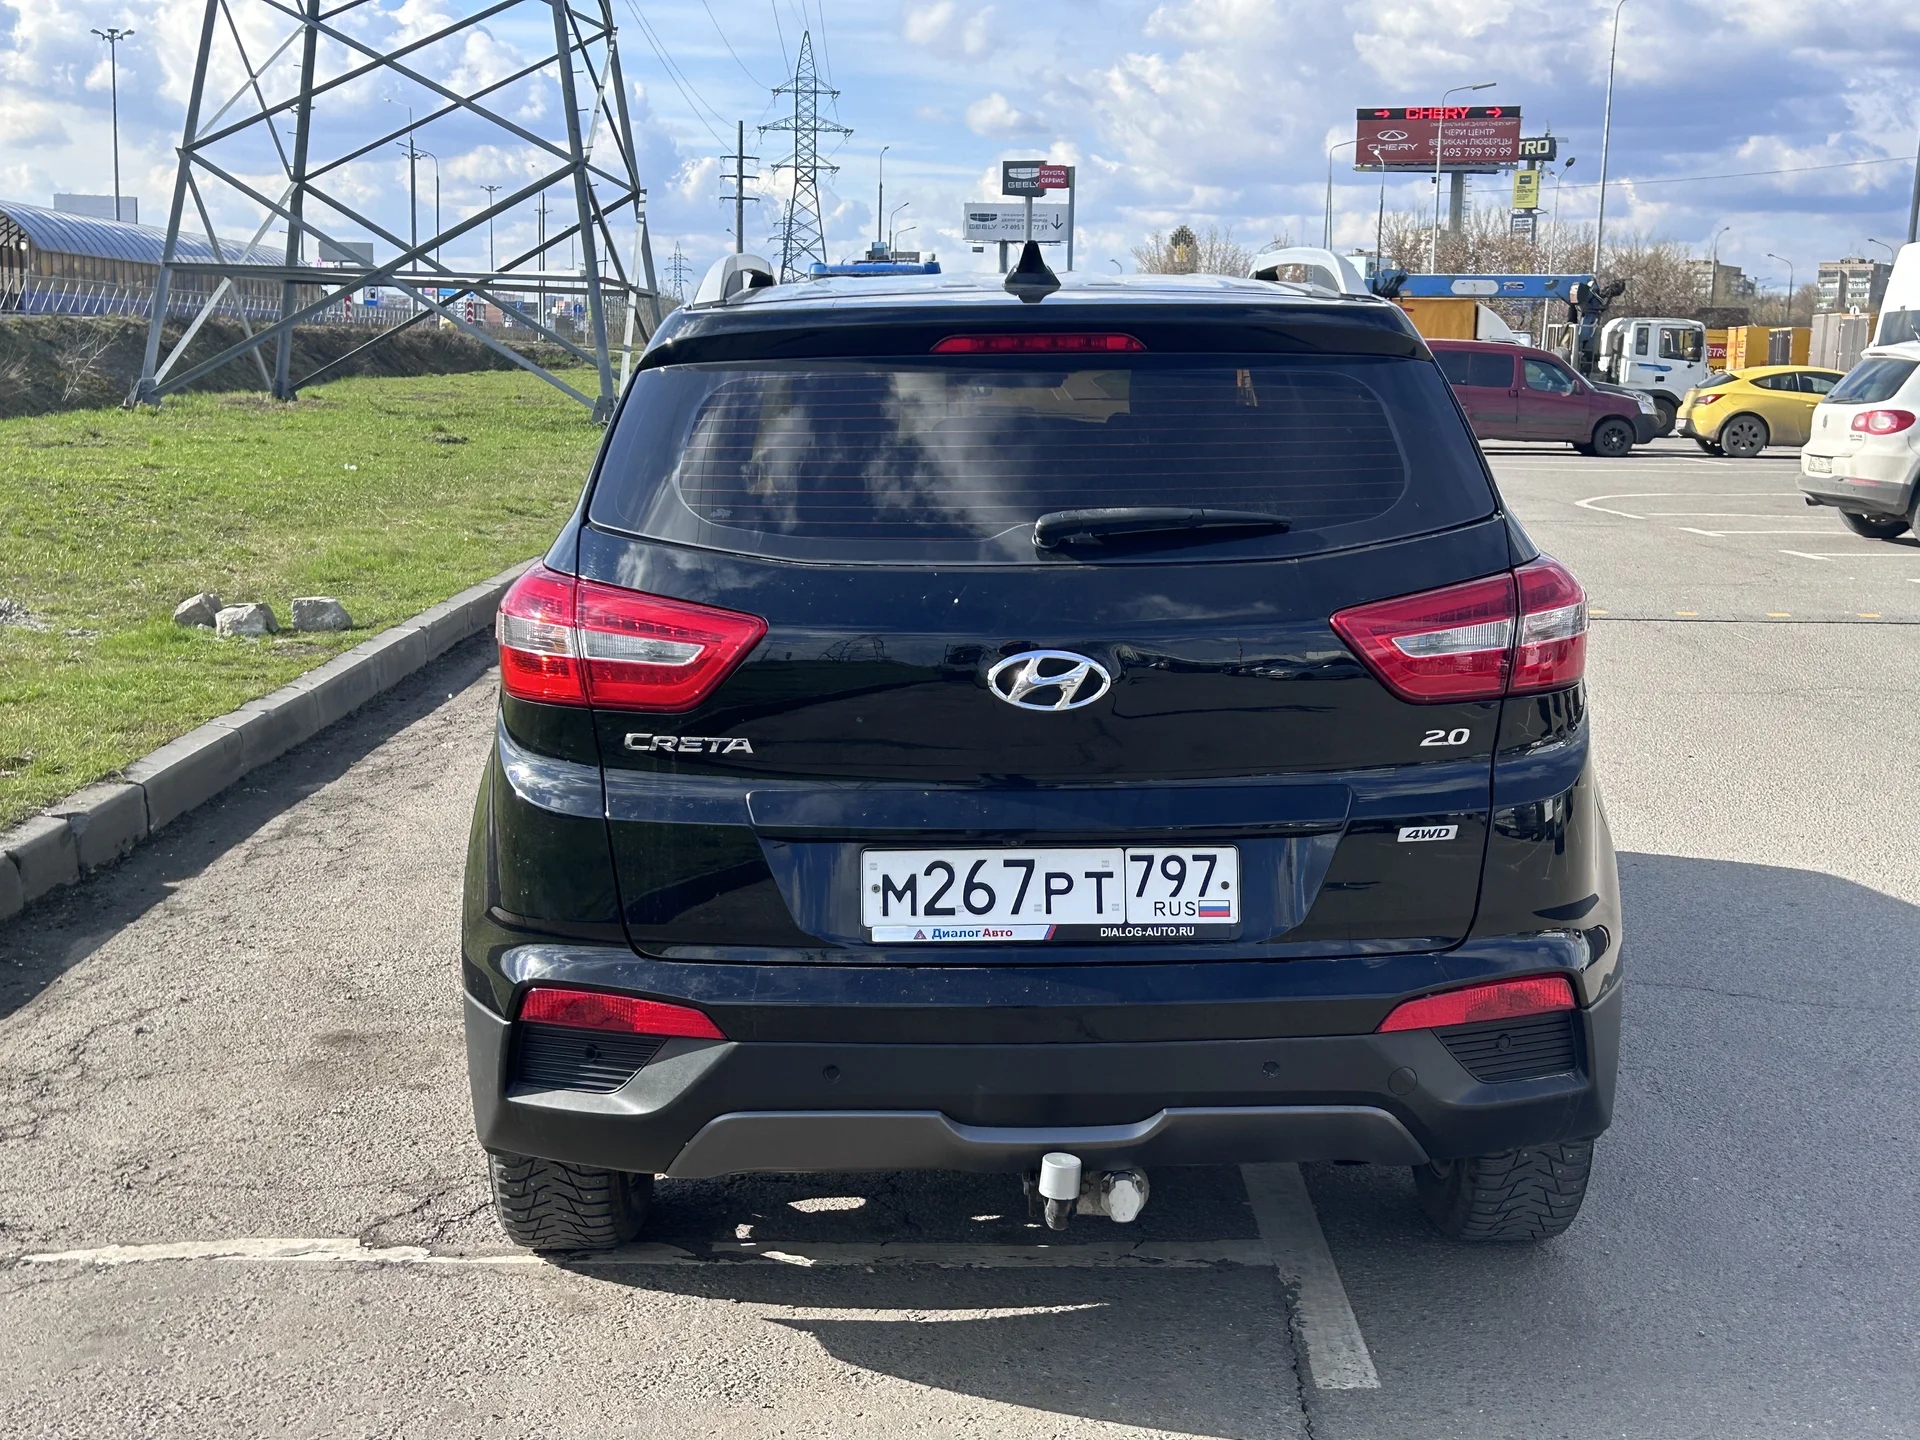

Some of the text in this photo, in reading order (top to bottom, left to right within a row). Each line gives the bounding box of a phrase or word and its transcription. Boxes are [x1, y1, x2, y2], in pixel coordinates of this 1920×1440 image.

[1405, 107, 1471, 120] CHERY
[1445, 128, 1496, 137] ЧЕРИ ЦЕНТР
[1367, 143, 1418, 151] CHERY
[1443, 147, 1462, 157] 495
[1464, 147, 1482, 157] 799
[1484, 147, 1497, 156] 99
[1499, 147, 1512, 156] 99
[1007, 181, 1040, 189] GEELY
[624, 732, 754, 754] CRETA
[1405, 828, 1451, 839] 4WD
[1129, 854, 1217, 898] 797
[1153, 901, 1196, 917] RUS
[1100, 925, 1195, 938] DIALOG-AUTO.RU
